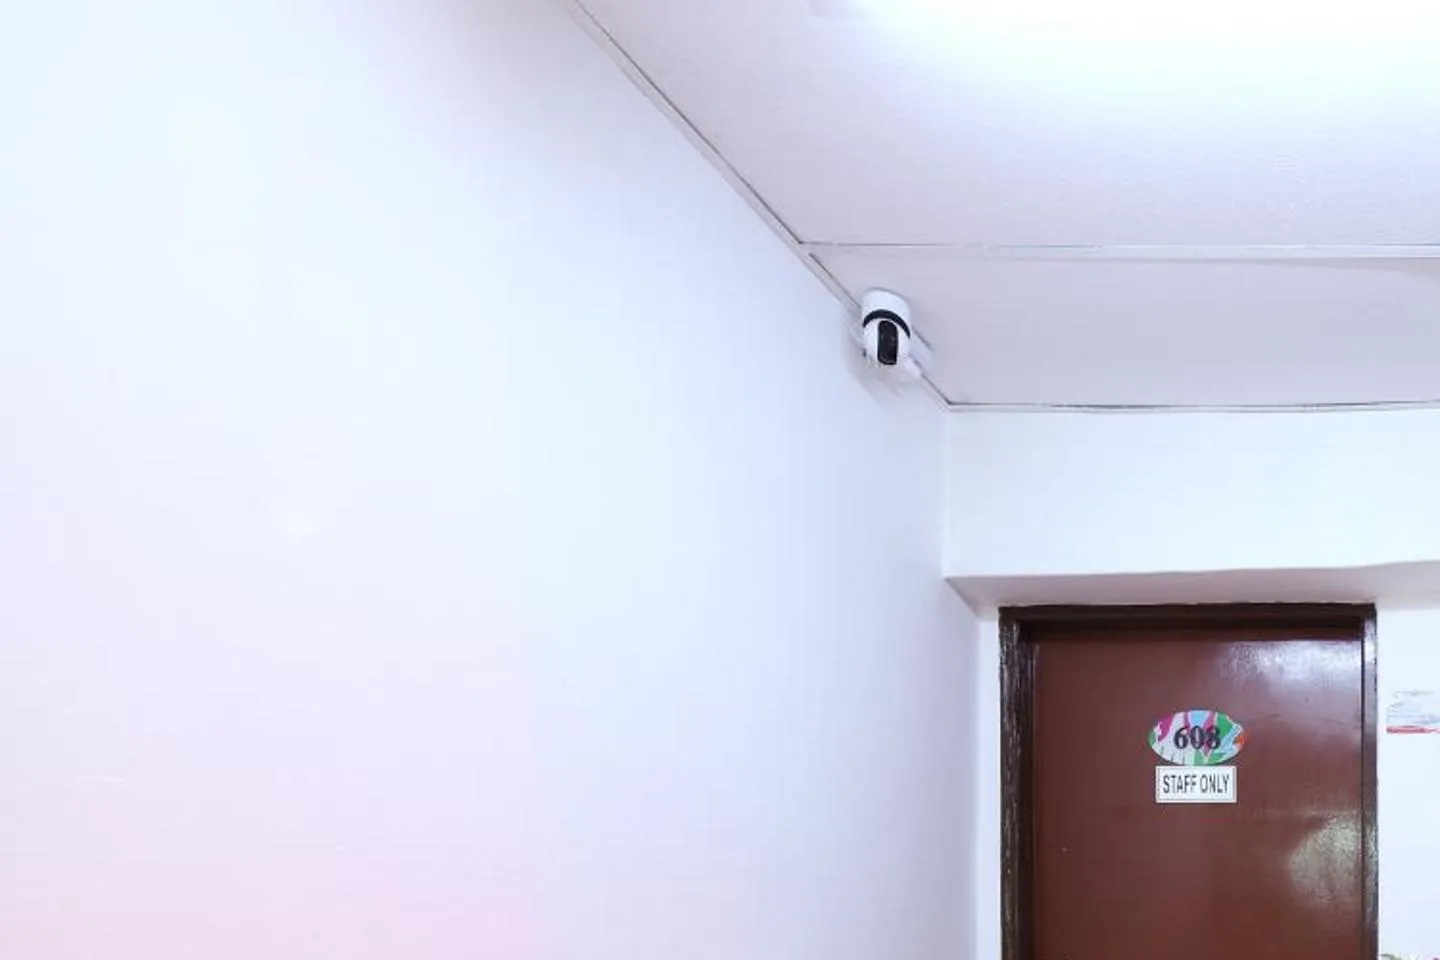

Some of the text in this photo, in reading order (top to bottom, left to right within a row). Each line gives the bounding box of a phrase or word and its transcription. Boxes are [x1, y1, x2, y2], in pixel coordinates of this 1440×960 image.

[1174, 725, 1220, 750] 608
[1163, 773, 1230, 794] STAFF ONLY
